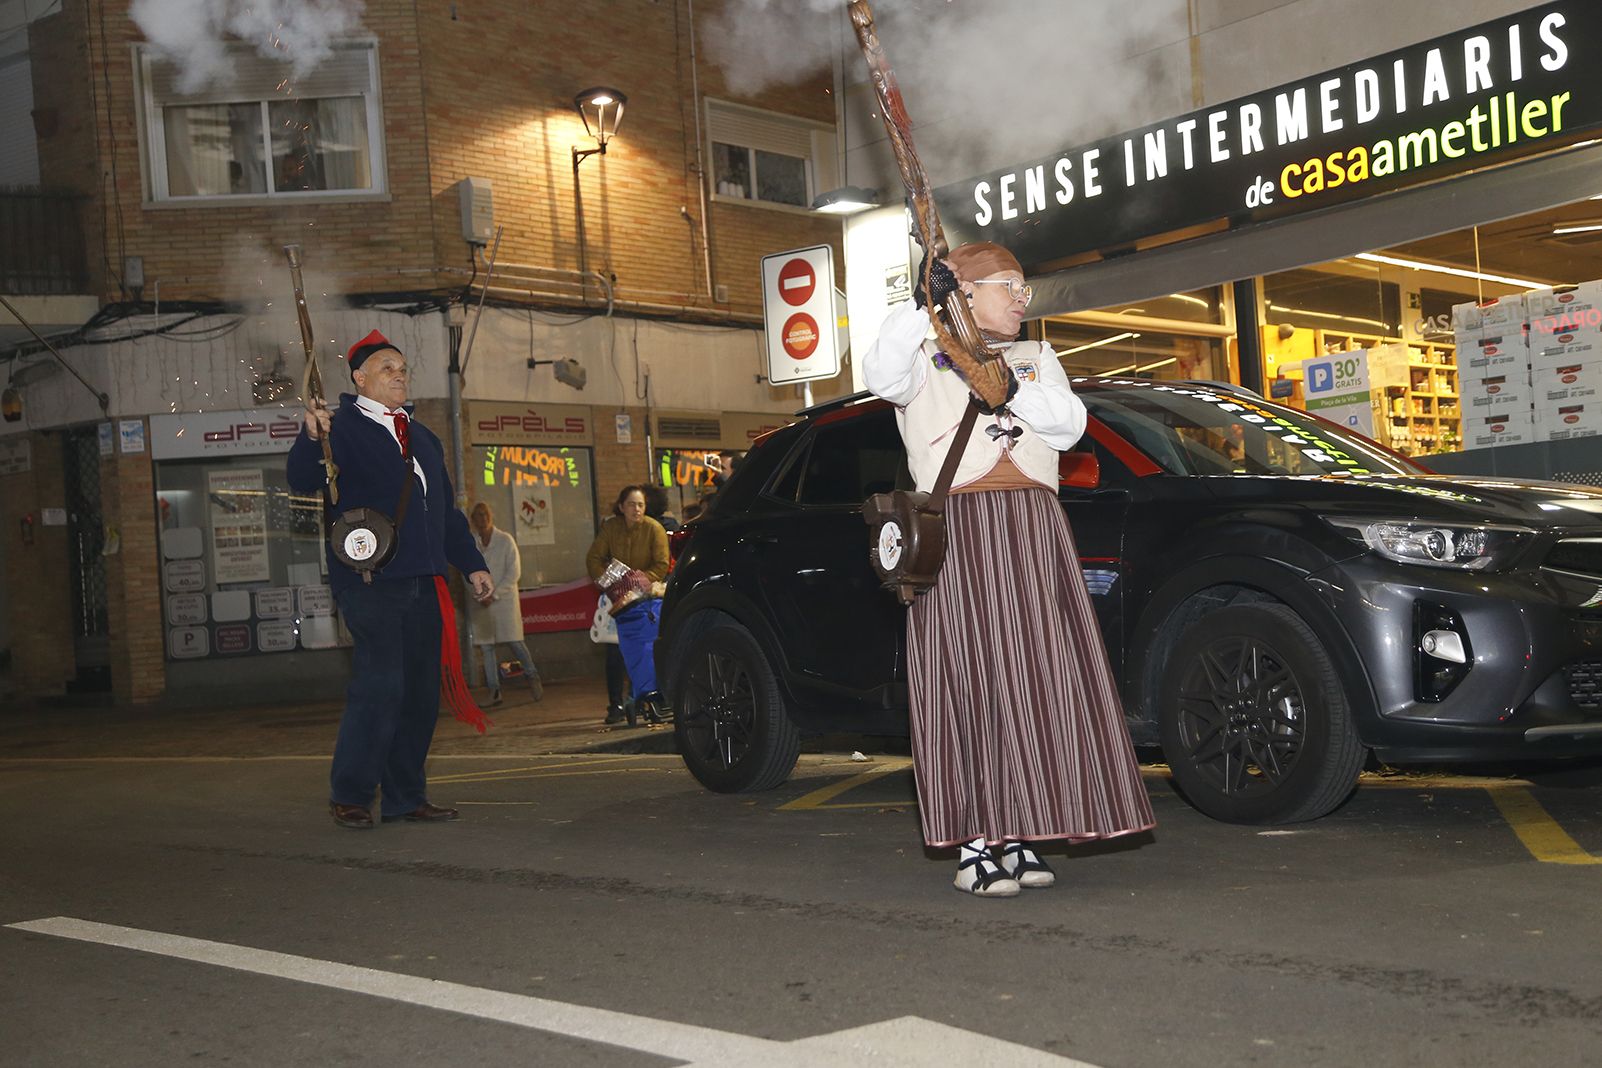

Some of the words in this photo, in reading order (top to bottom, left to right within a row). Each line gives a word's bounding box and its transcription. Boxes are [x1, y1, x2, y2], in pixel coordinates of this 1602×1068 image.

[974, 148, 1102, 227] SENSE
[1124, 11, 1569, 187] INTERMEDIARIS
[1246, 175, 1275, 209] de
[1335, 378, 1362, 389] GRATIS
[204, 414, 300, 443] dPÈ
